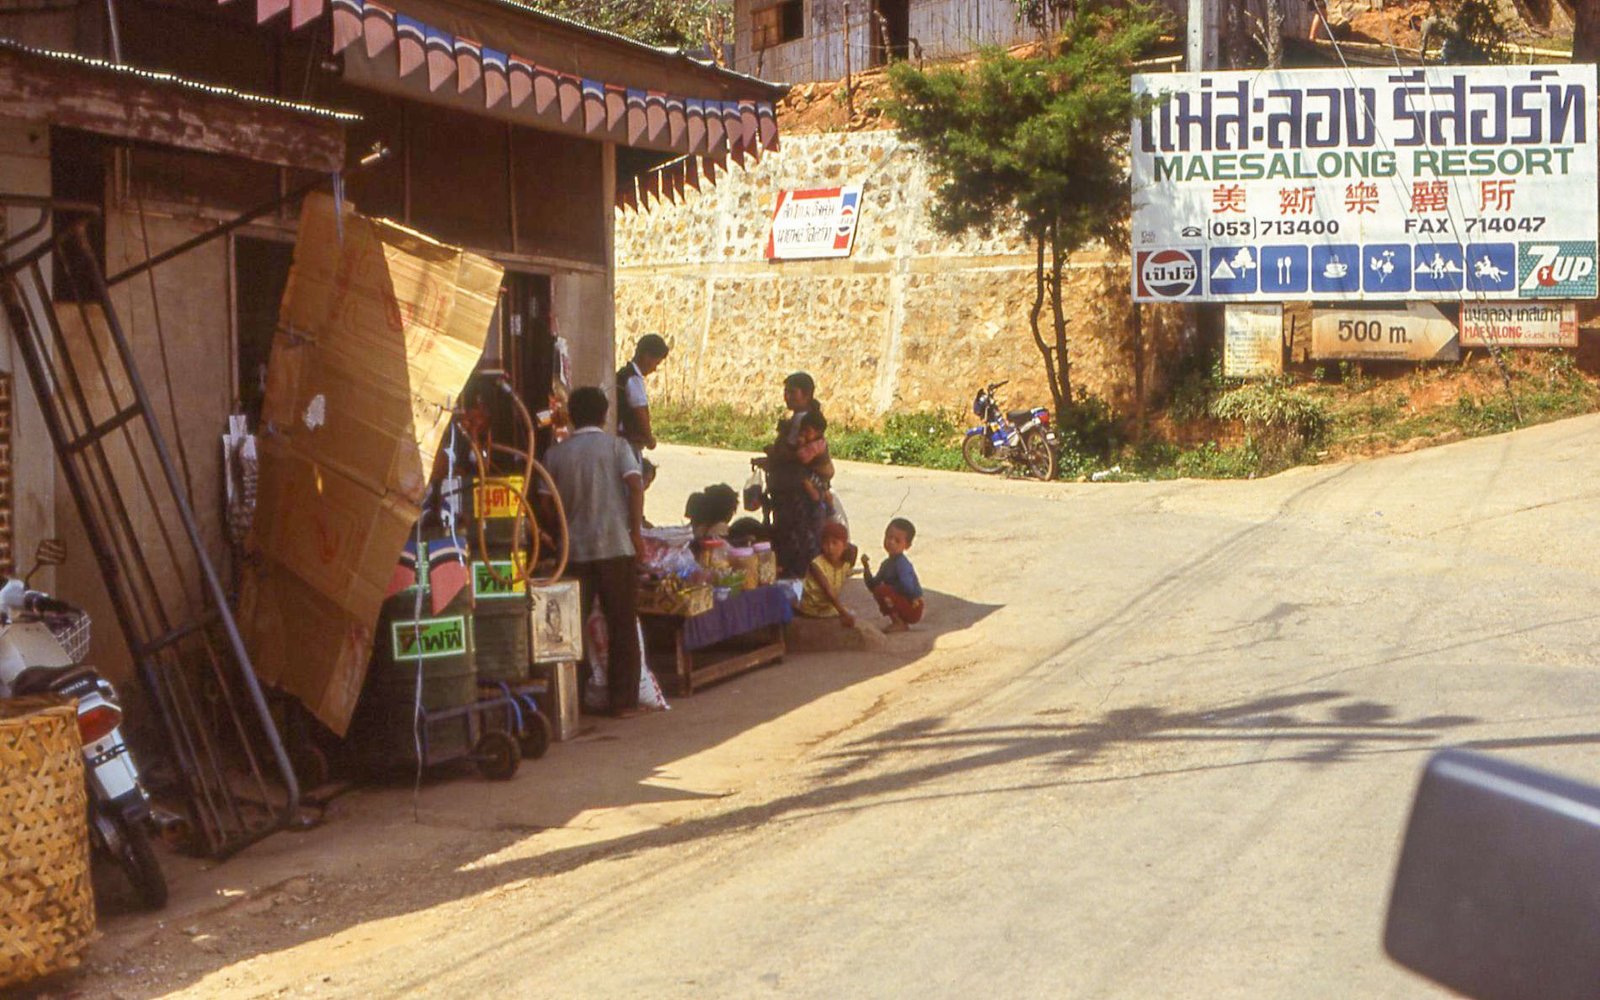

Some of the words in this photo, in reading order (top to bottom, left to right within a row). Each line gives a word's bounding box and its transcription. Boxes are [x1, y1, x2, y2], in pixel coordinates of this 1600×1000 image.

[1141, 78, 1376, 153] แม่สะลอง
[1388, 70, 1587, 147] รีสอร์ท
[1153, 150, 1396, 182] MAESALONG
[1413, 147, 1575, 177] RESORT
[1404, 218, 1449, 234] FAX
[1464, 217, 1546, 234] 714047
[1338, 320, 1382, 342] 500
[1389, 326, 1413, 343] m.
[1464, 326, 1523, 338] MAESALONG
